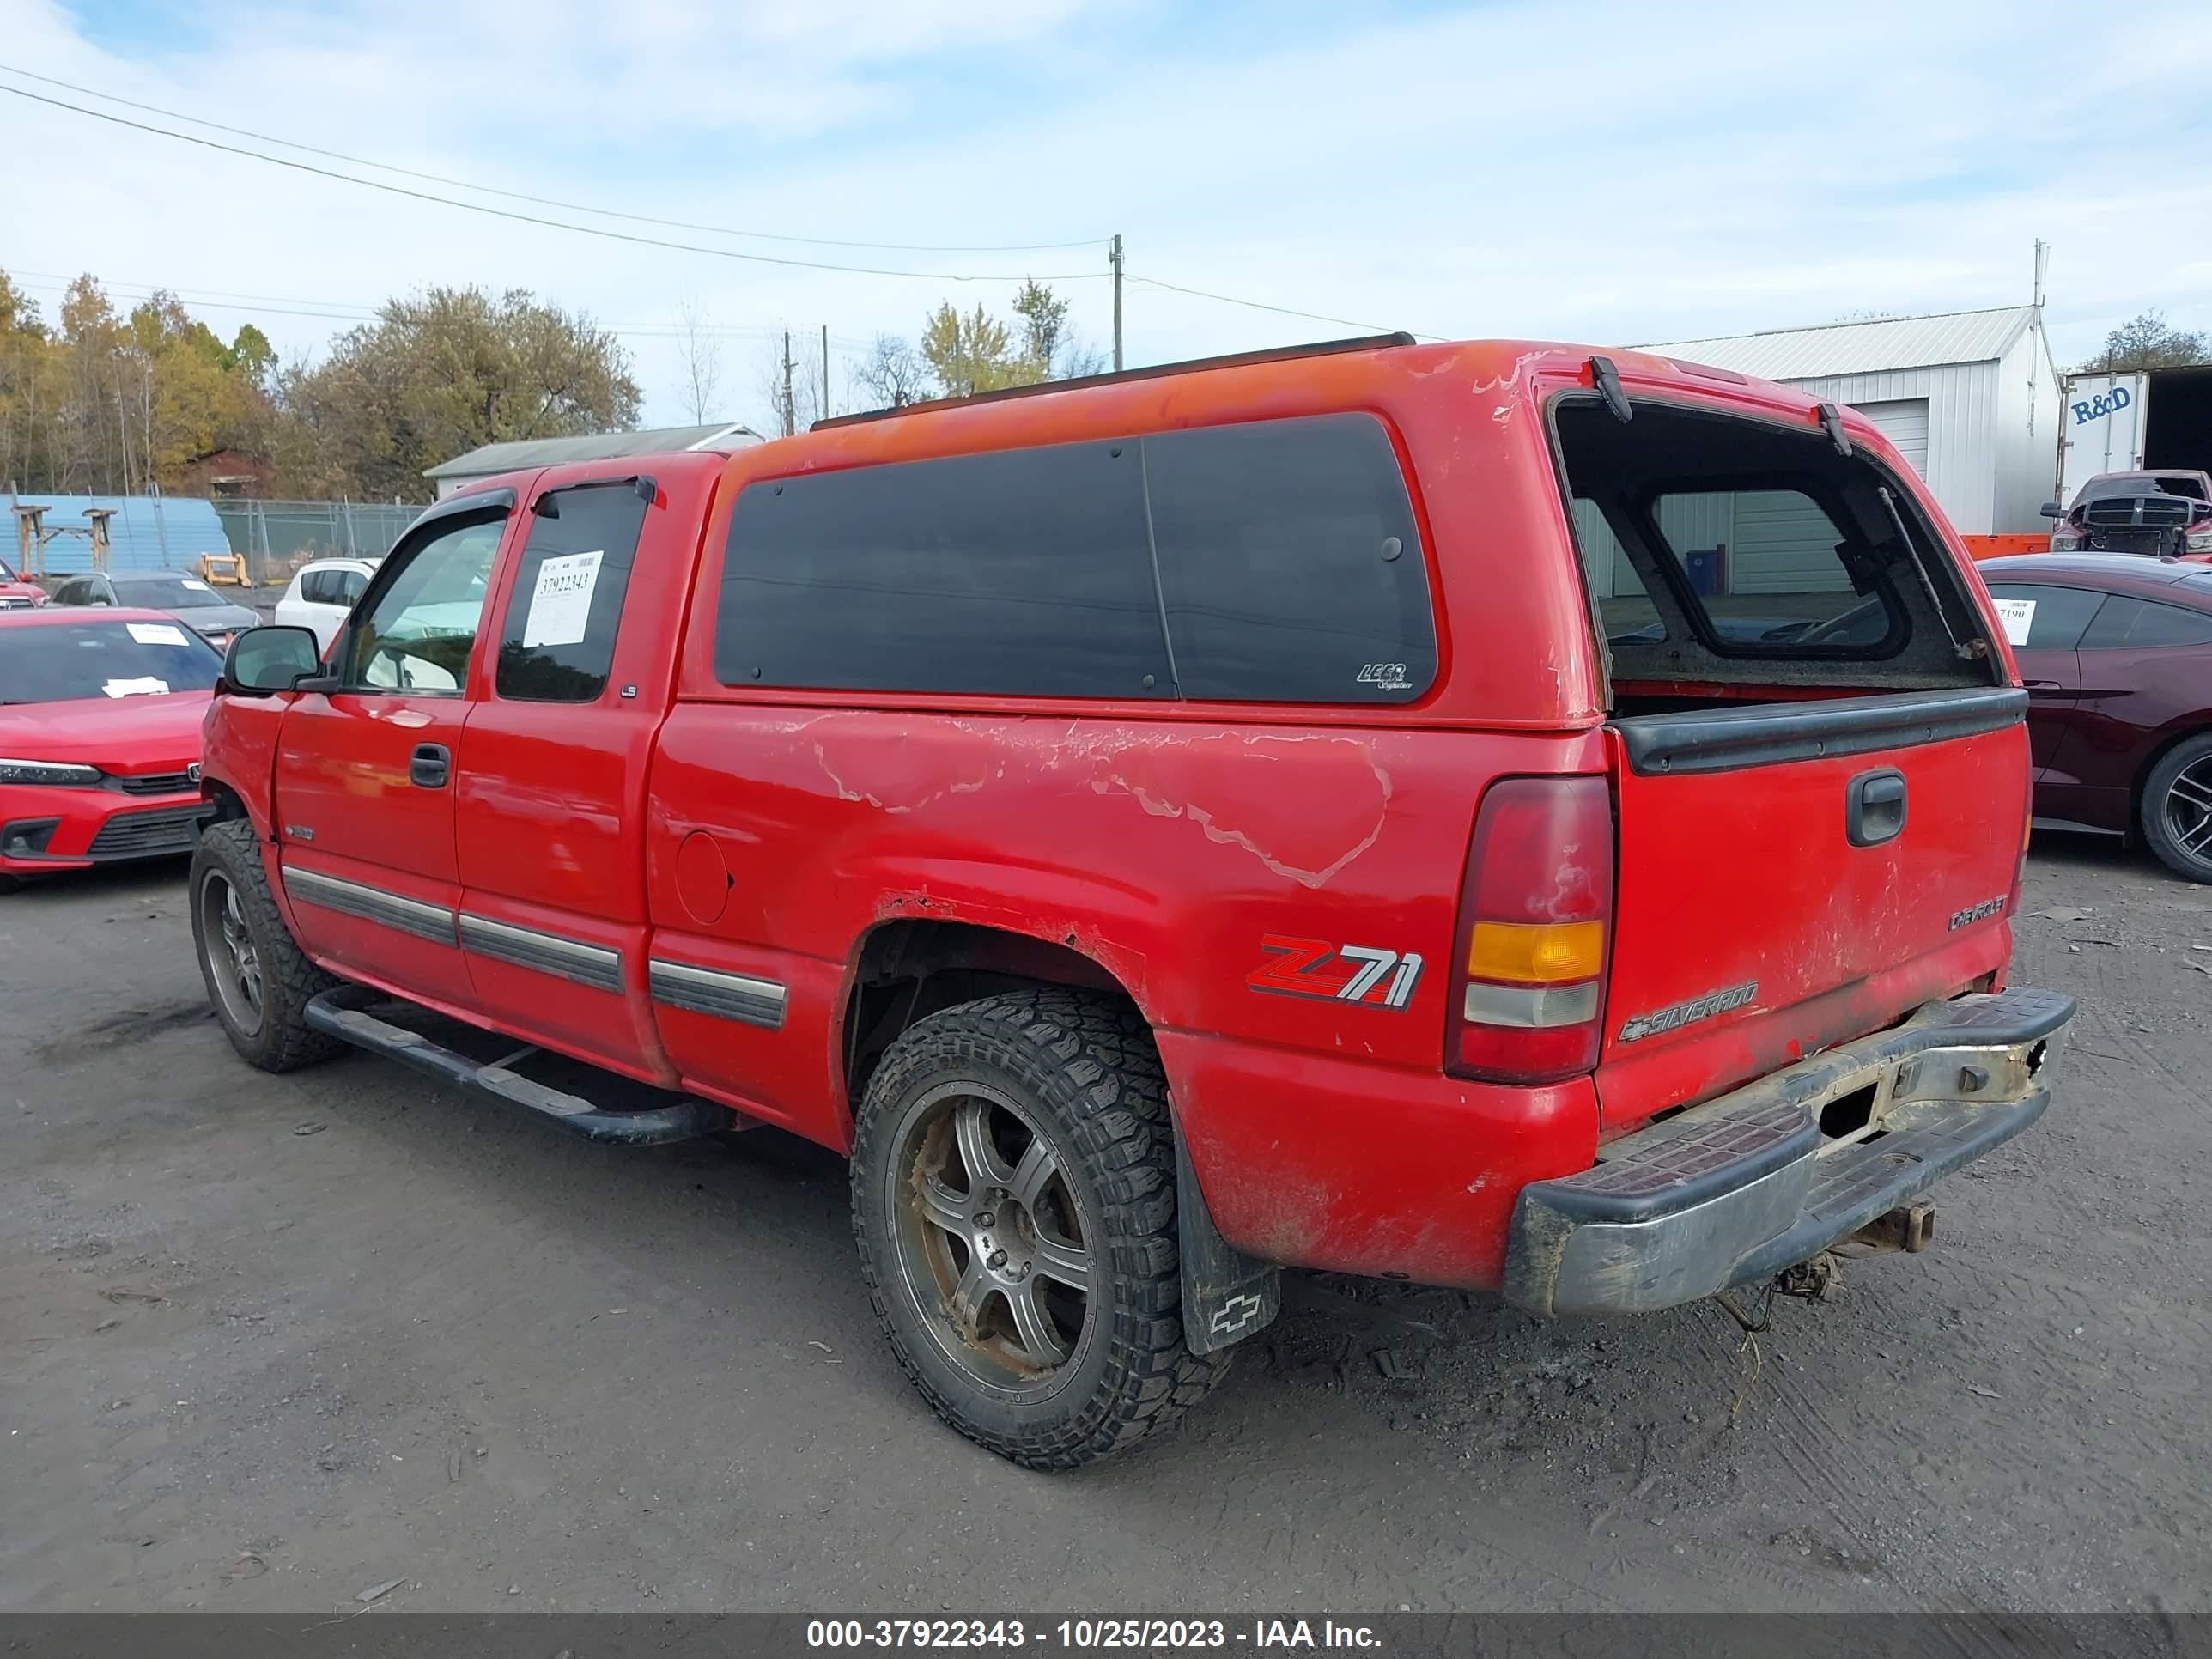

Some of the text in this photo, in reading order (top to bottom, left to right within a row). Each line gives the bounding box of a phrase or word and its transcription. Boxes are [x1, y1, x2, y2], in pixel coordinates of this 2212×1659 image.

[2071, 387, 2130, 425] R&D
[540, 573, 589, 594] 37922343
[2000, 609, 2025, 618] 7190
[1357, 664, 1407, 682] LEER
[621, 686, 637, 696] LS
[1948, 894, 2008, 932] CHEVROLET
[1246, 933, 1426, 1014] Z71
[1648, 981, 1759, 1036] SILVERADO
